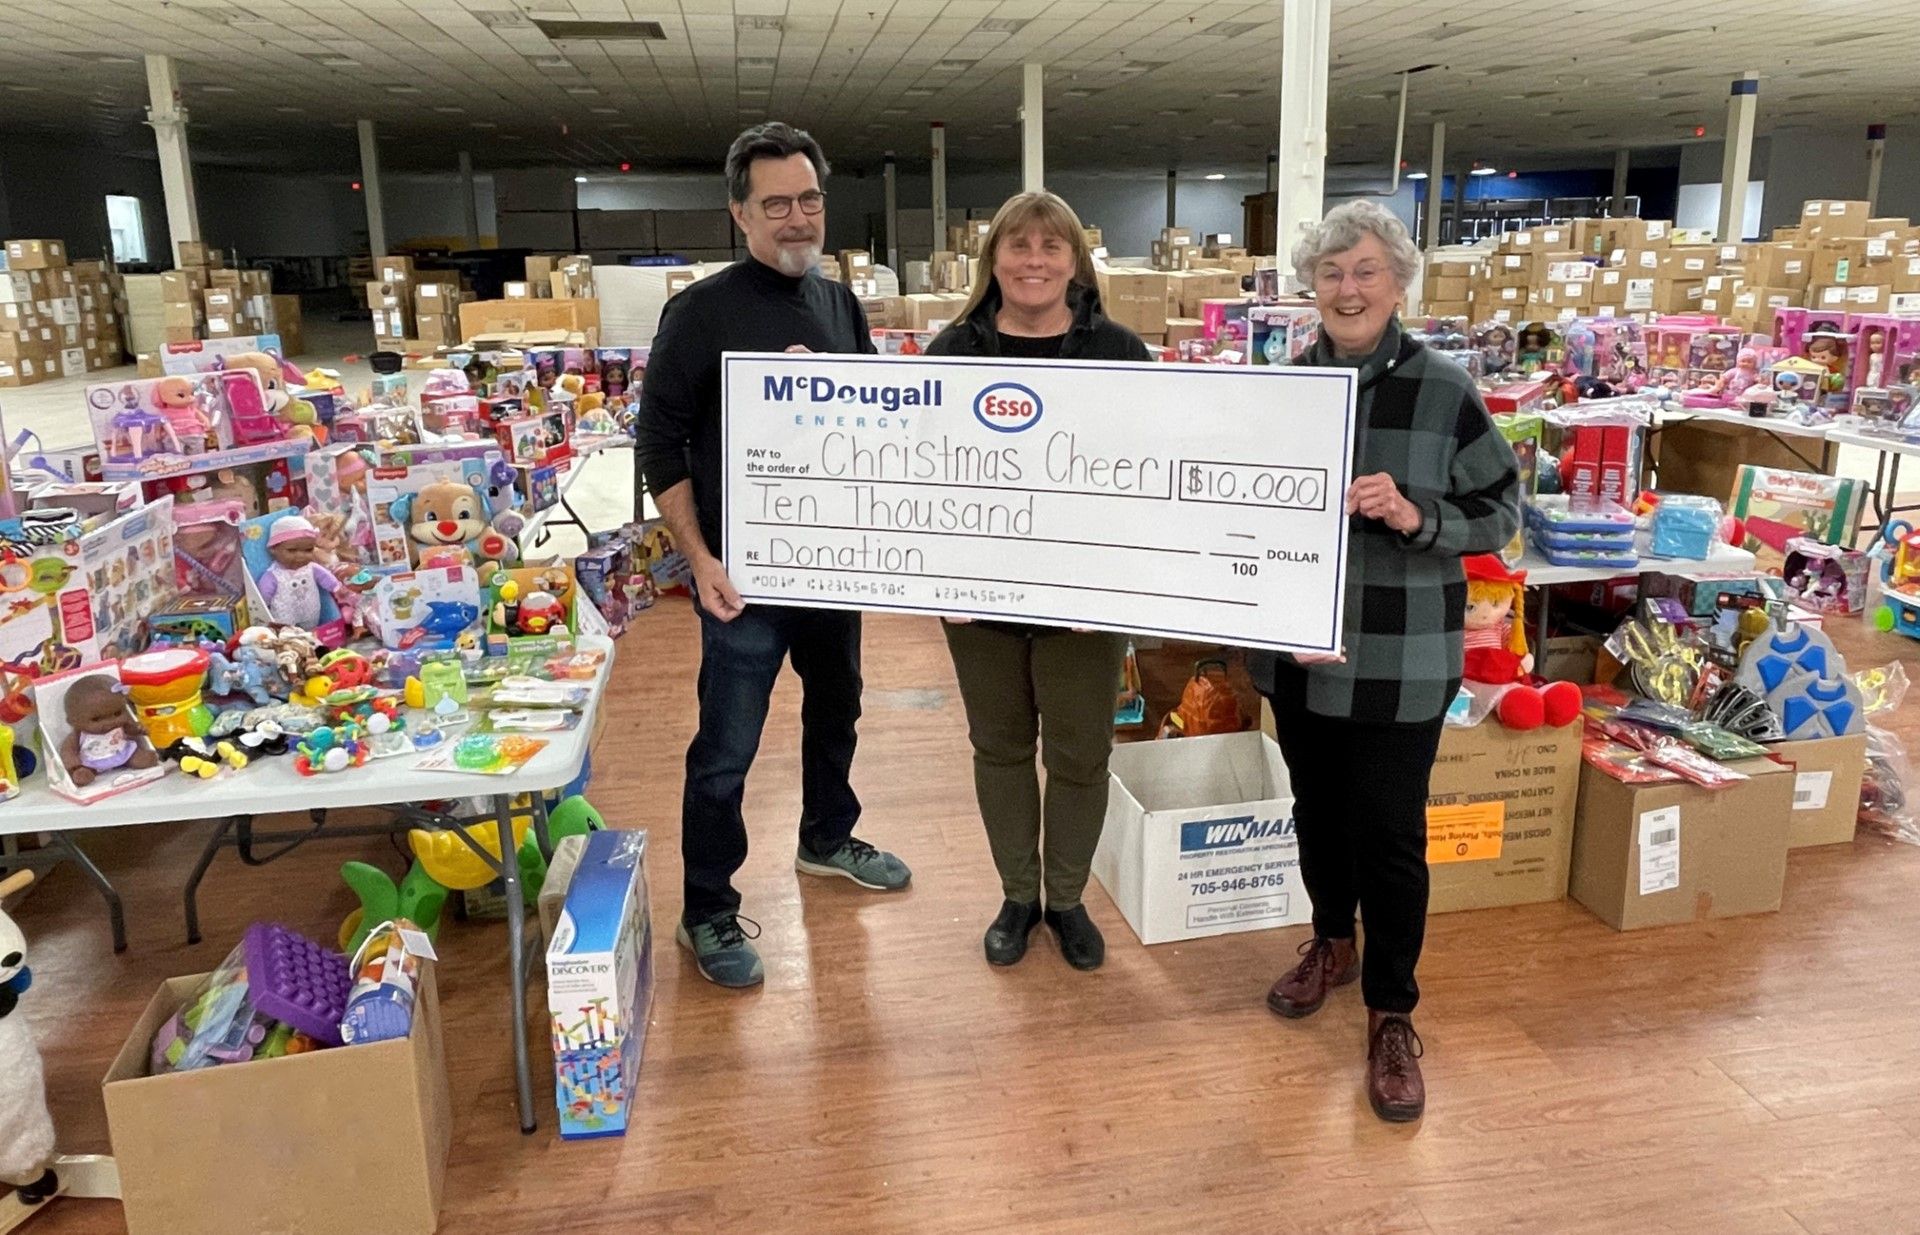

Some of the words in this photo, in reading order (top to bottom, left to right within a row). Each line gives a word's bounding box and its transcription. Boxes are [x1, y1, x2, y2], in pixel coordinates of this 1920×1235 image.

[764, 376, 942, 412] McDougall
[984, 395, 1033, 417] Esso
[795, 415, 910, 429] ENERGY
[746, 448, 767, 458] PAY
[769, 450, 781, 459] to
[747, 462, 764, 472] the
[767, 463, 795, 473] order
[798, 464, 810, 474] of
[821, 431, 1023, 482] Christmas
[1045, 431, 1159, 491] Cheer
[751, 482, 817, 522] Ten
[843, 485, 1034, 536] Thousand
[746, 551, 759, 560] RE
[769, 534, 924, 572] Donation
[1266, 549, 1320, 563] DOLLAR
[1231, 563, 1258, 576] 100
[1495, 769, 1520, 779] CHINA
[1522, 767, 1531, 776] IN
[1521, 786, 1554, 798] CARTON
[1177, 872, 1189, 881] 24
[1206, 864, 1262, 877] EMERGENCY
[1191, 873, 1284, 896] 705-946-8765
[552, 964, 610, 976] DISCOVERY
